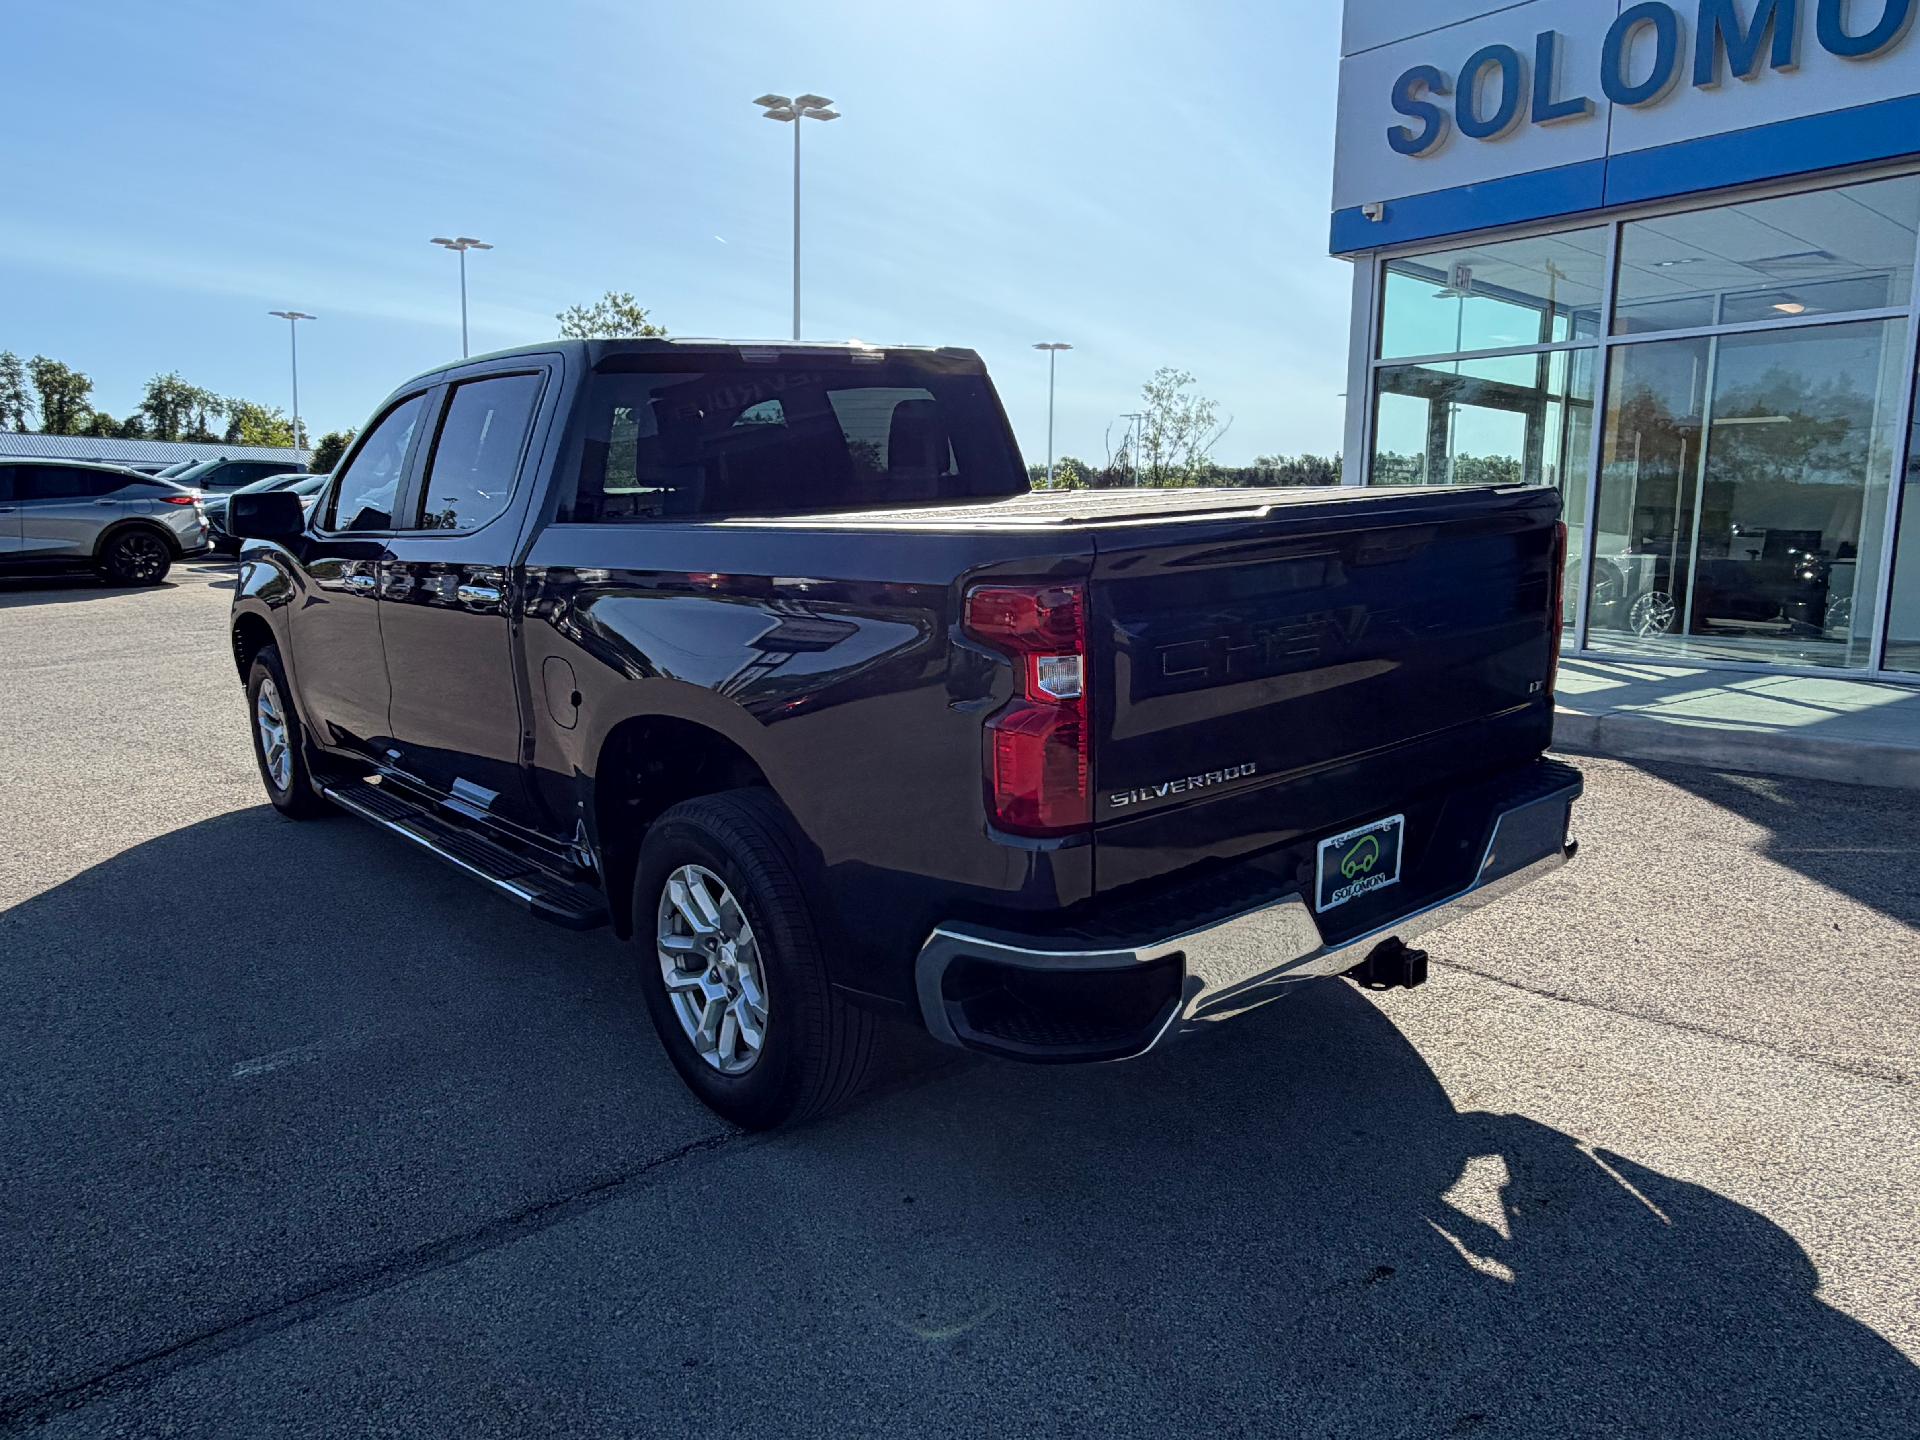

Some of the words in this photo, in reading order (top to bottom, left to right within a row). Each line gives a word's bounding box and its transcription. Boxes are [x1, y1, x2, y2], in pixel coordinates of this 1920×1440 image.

[1529, 680, 1544, 693] LT
[1110, 762, 1256, 807] SILVERADO
[1332, 873, 1386, 902] SOLOMON
